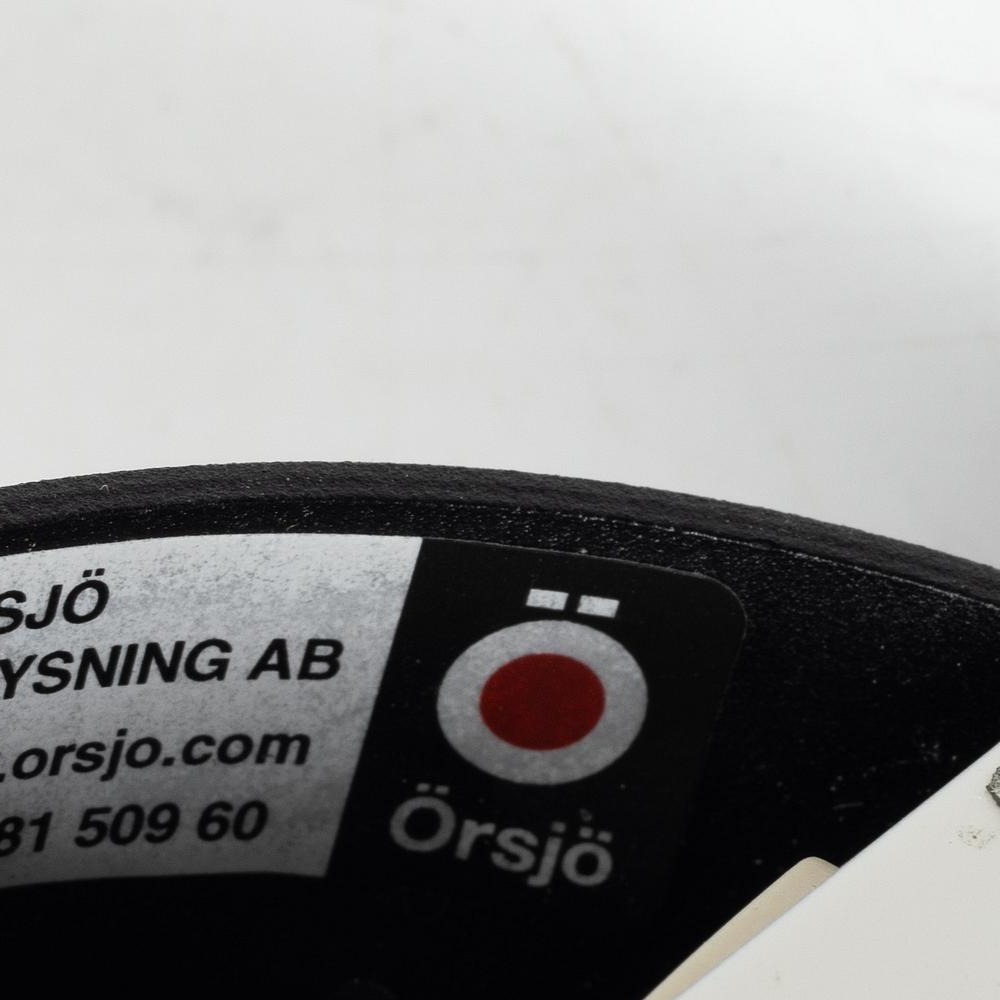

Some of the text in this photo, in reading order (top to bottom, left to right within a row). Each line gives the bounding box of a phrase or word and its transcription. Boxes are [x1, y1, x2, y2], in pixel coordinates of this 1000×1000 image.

[248, 638, 344, 680] AB
[74, 803, 180, 848] 509
[196, 800, 267, 841] 60
[390, 783, 613, 887] Örsjö
